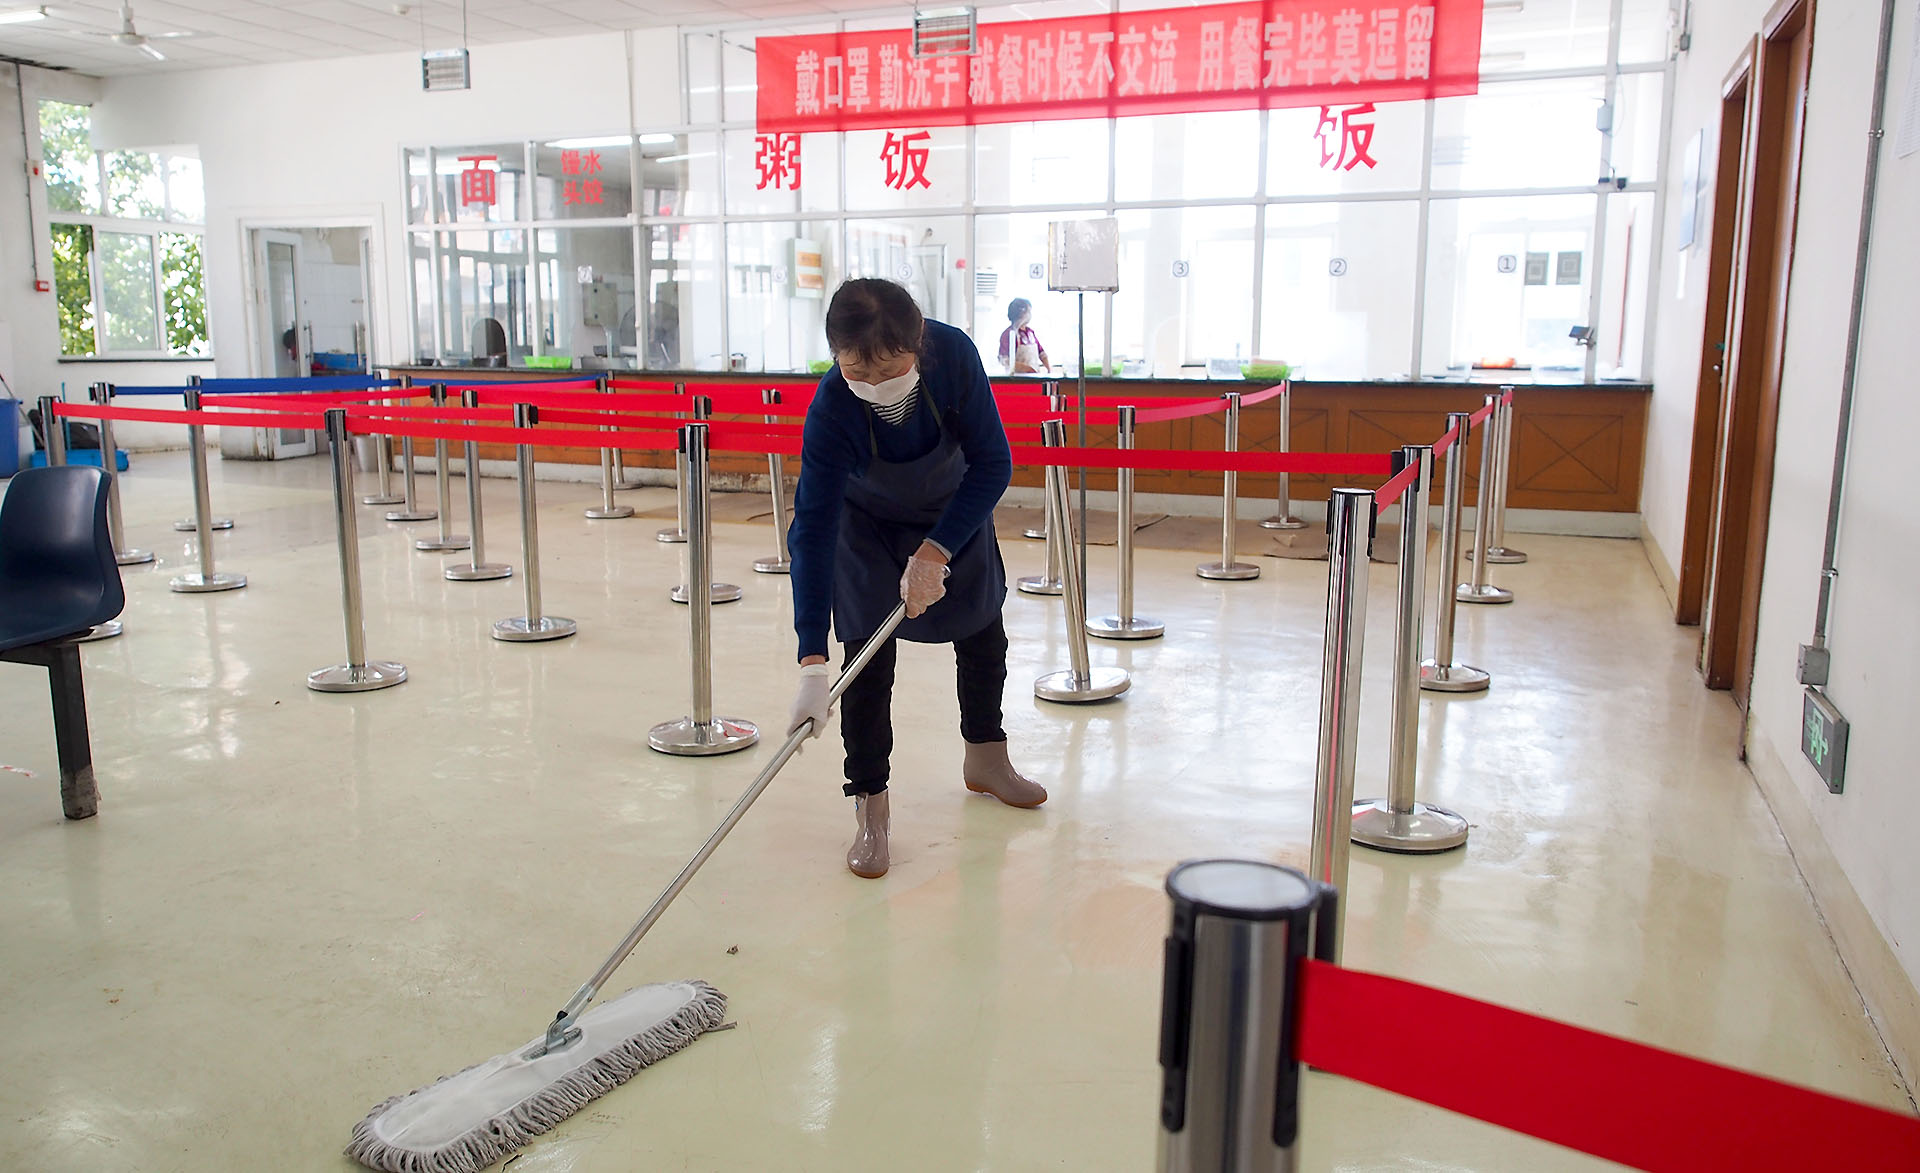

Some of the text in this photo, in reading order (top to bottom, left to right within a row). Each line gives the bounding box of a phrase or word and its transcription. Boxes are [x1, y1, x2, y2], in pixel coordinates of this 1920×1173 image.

[796, 5, 1434, 115] 戴口罩 勤洗手 就餐时候不交流 用餐完毕莫逗留
[755, 132, 801, 190] 粥
[880, 130, 932, 190] 饭
[1313, 102, 1377, 172] 饭
[457, 155, 498, 207] 面
